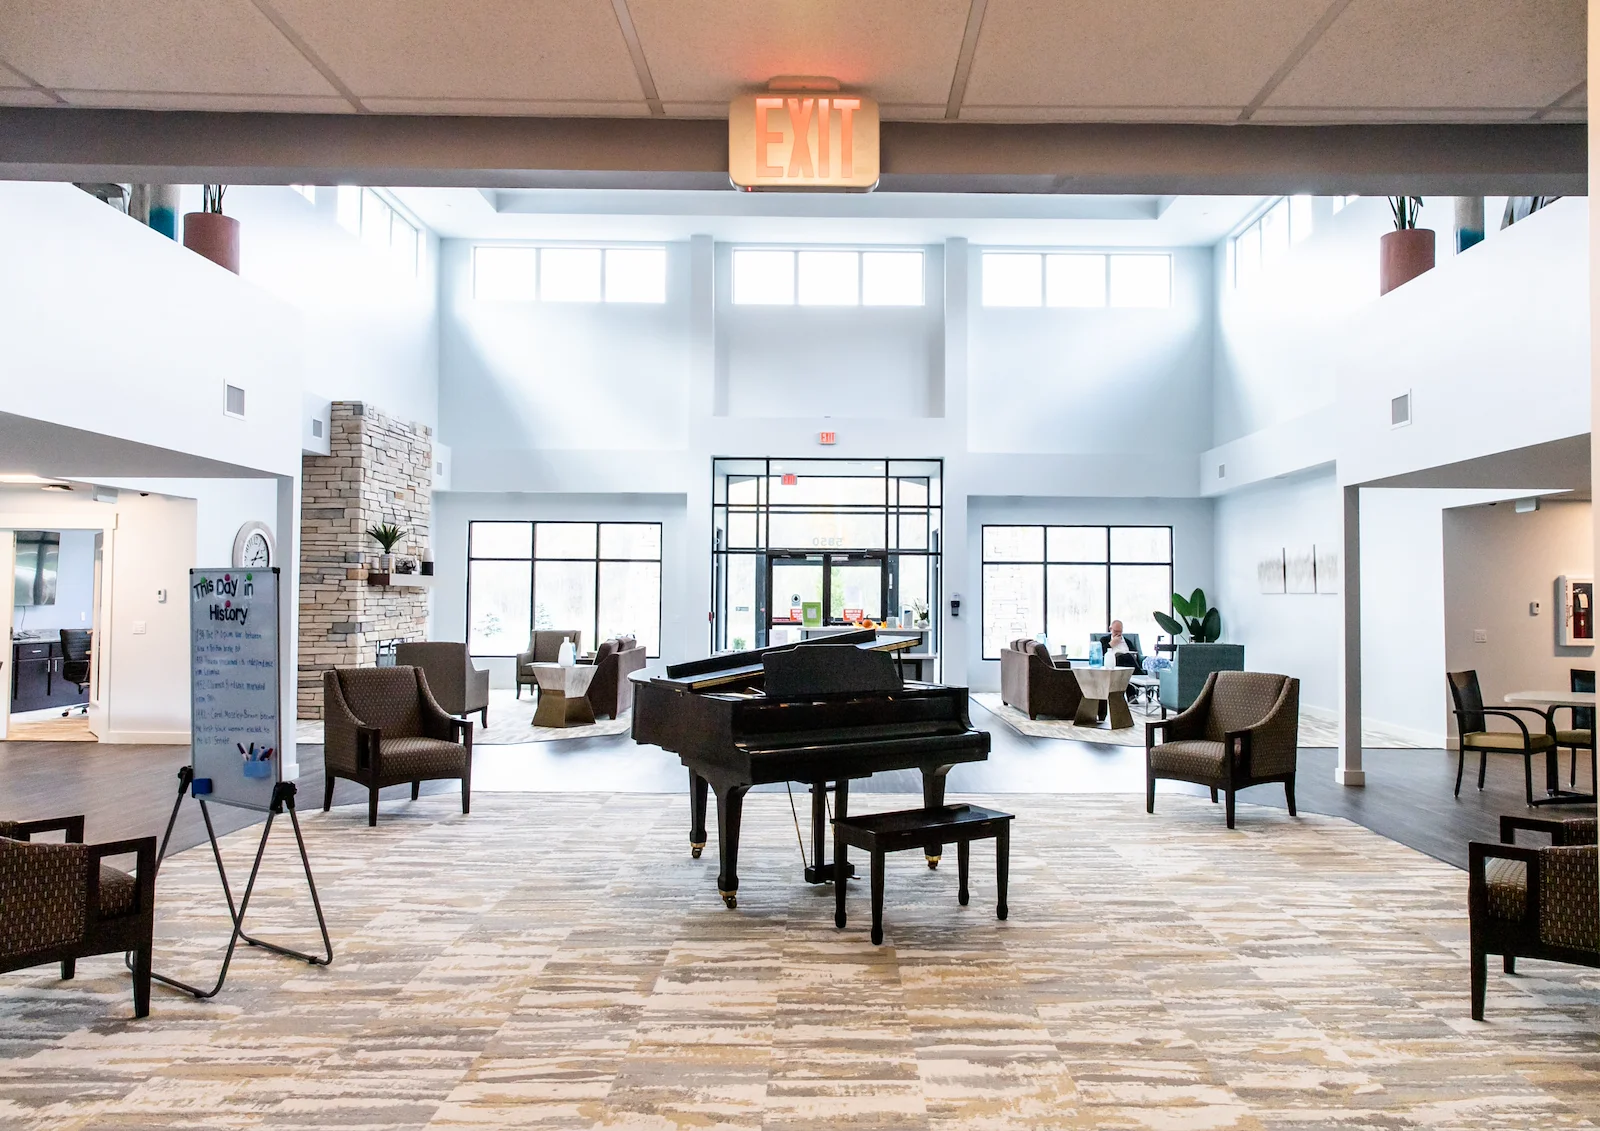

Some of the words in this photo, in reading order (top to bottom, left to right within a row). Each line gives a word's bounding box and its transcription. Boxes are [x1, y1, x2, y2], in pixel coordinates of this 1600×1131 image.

[755, 97, 861, 178] EXIT
[820, 432, 835, 442] EXIT
[193, 579, 214, 600] This
[216, 578, 238, 597] Day
[244, 579, 254, 596] in
[209, 604, 248, 626] History
